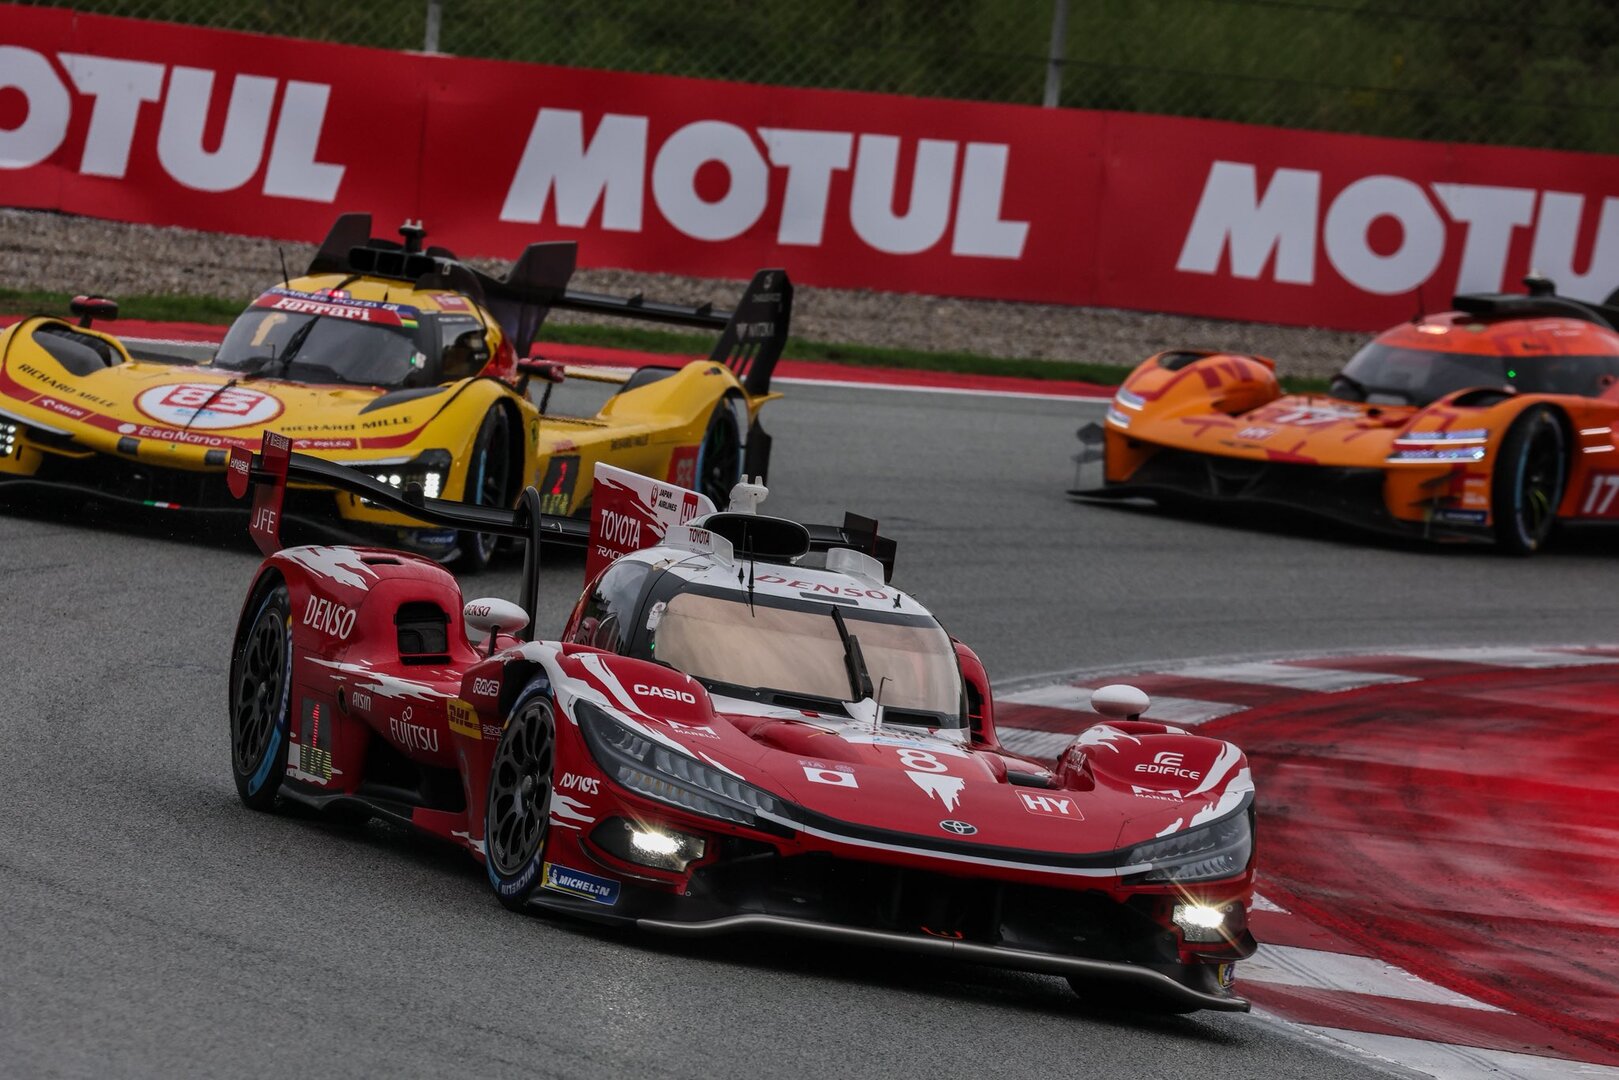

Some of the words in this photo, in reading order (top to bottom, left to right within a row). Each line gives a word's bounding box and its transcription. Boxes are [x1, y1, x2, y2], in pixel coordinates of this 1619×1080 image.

[0, 44, 346, 203] OTUL
[499, 107, 1030, 259] MOTUL
[1174, 159, 1619, 306] MOTU
[272, 297, 371, 322] Ferrari
[18, 363, 76, 394] RICHARD
[77, 391, 117, 408] MILLE
[166, 387, 257, 413] 83
[362, 416, 412, 429] MILLE
[659, 489, 673, 500] JAPAN
[1584, 474, 1619, 514] 17
[658, 501, 678, 512] AIRLINES
[253, 507, 276, 534] JFE
[600, 509, 641, 549] TOYOTA
[689, 528, 710, 546] TOYOTA
[597, 544, 625, 560] RACI
[755, 575, 888, 600] DENSO
[303, 594, 357, 640] DENSO
[464, 605, 490, 617] DENSO
[473, 677, 500, 697] RAYS
[633, 684, 696, 704] CASIO
[352, 691, 371, 712] AISIN
[390, 717, 438, 752] FUJITSU
[674, 729, 720, 740] MARELLI
[896, 748, 948, 773] 8
[1134, 764, 1201, 781] EDIFICE
[1021, 793, 1071, 815] HY
[1135, 793, 1185, 803] MARELLI
[558, 875, 611, 896] MICHELIN
